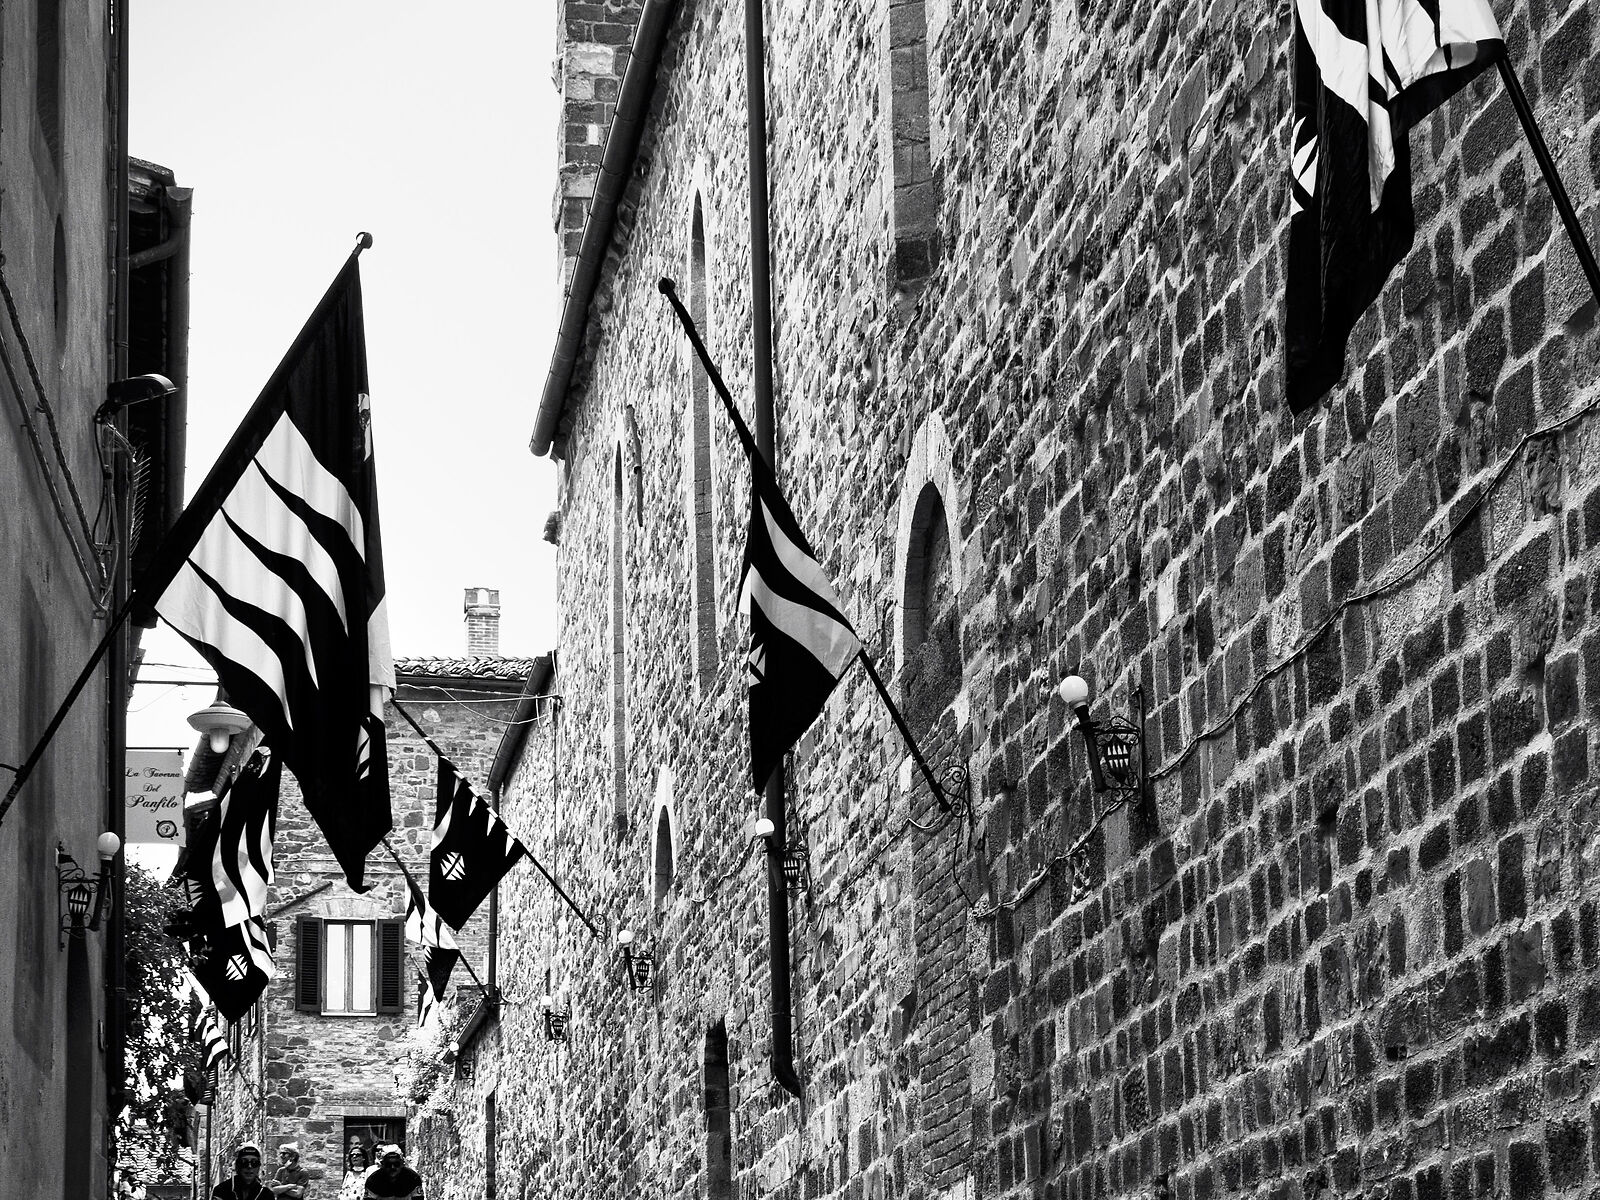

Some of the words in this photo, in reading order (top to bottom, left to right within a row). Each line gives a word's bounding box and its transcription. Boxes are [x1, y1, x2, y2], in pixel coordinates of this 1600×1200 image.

[125, 767, 139, 778] La
[143, 767, 181, 778] Taverna
[143, 783, 162, 793] Del
[125, 795, 179, 813] Panfilo
